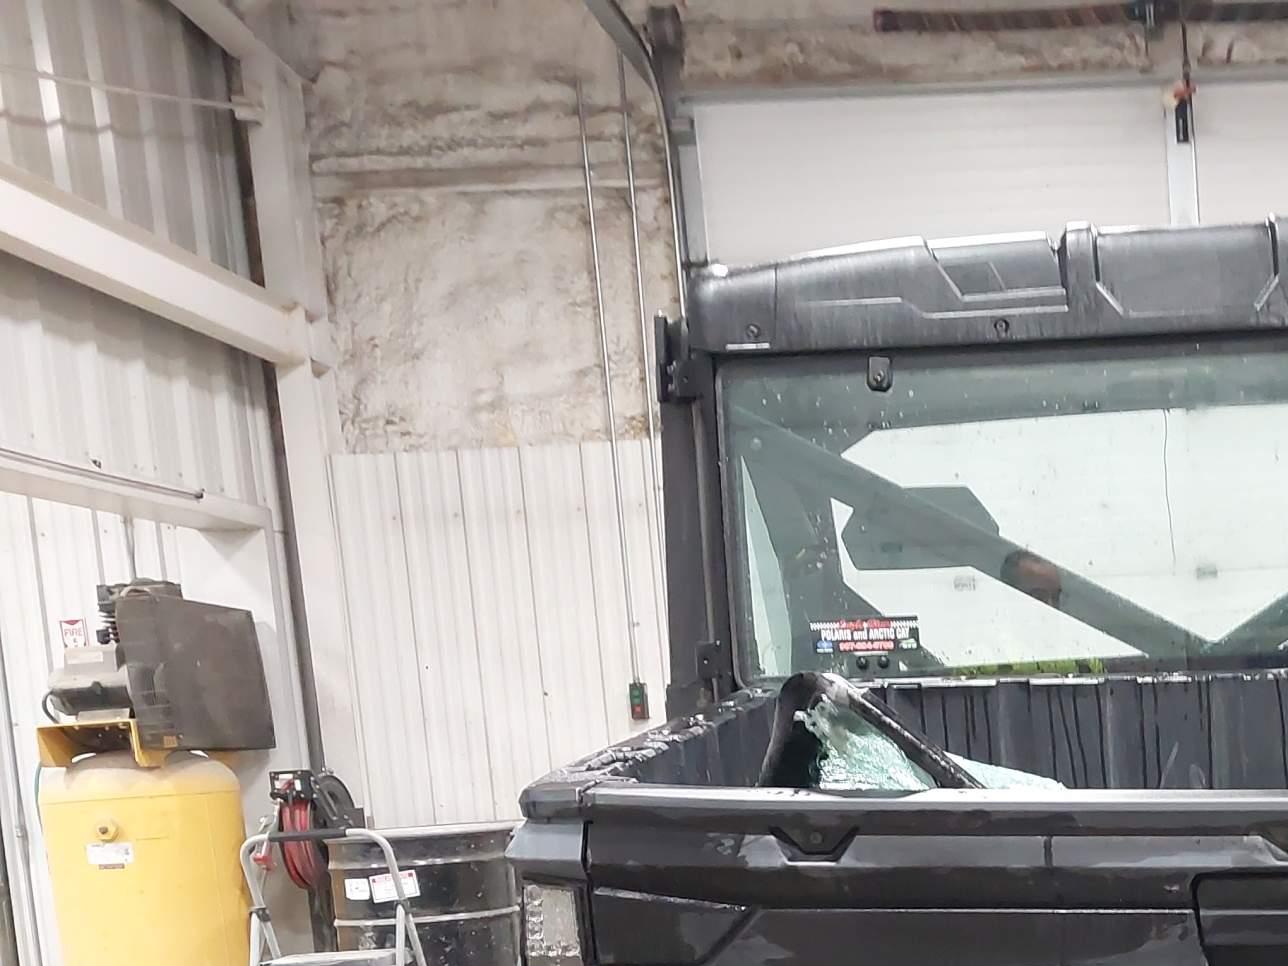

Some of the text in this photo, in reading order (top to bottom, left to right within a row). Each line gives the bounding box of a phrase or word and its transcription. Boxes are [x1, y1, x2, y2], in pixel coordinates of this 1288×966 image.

[64, 627, 83, 638] FIRE
[820, 629, 852, 641] POLARIS
[853, 627, 867, 640] and
